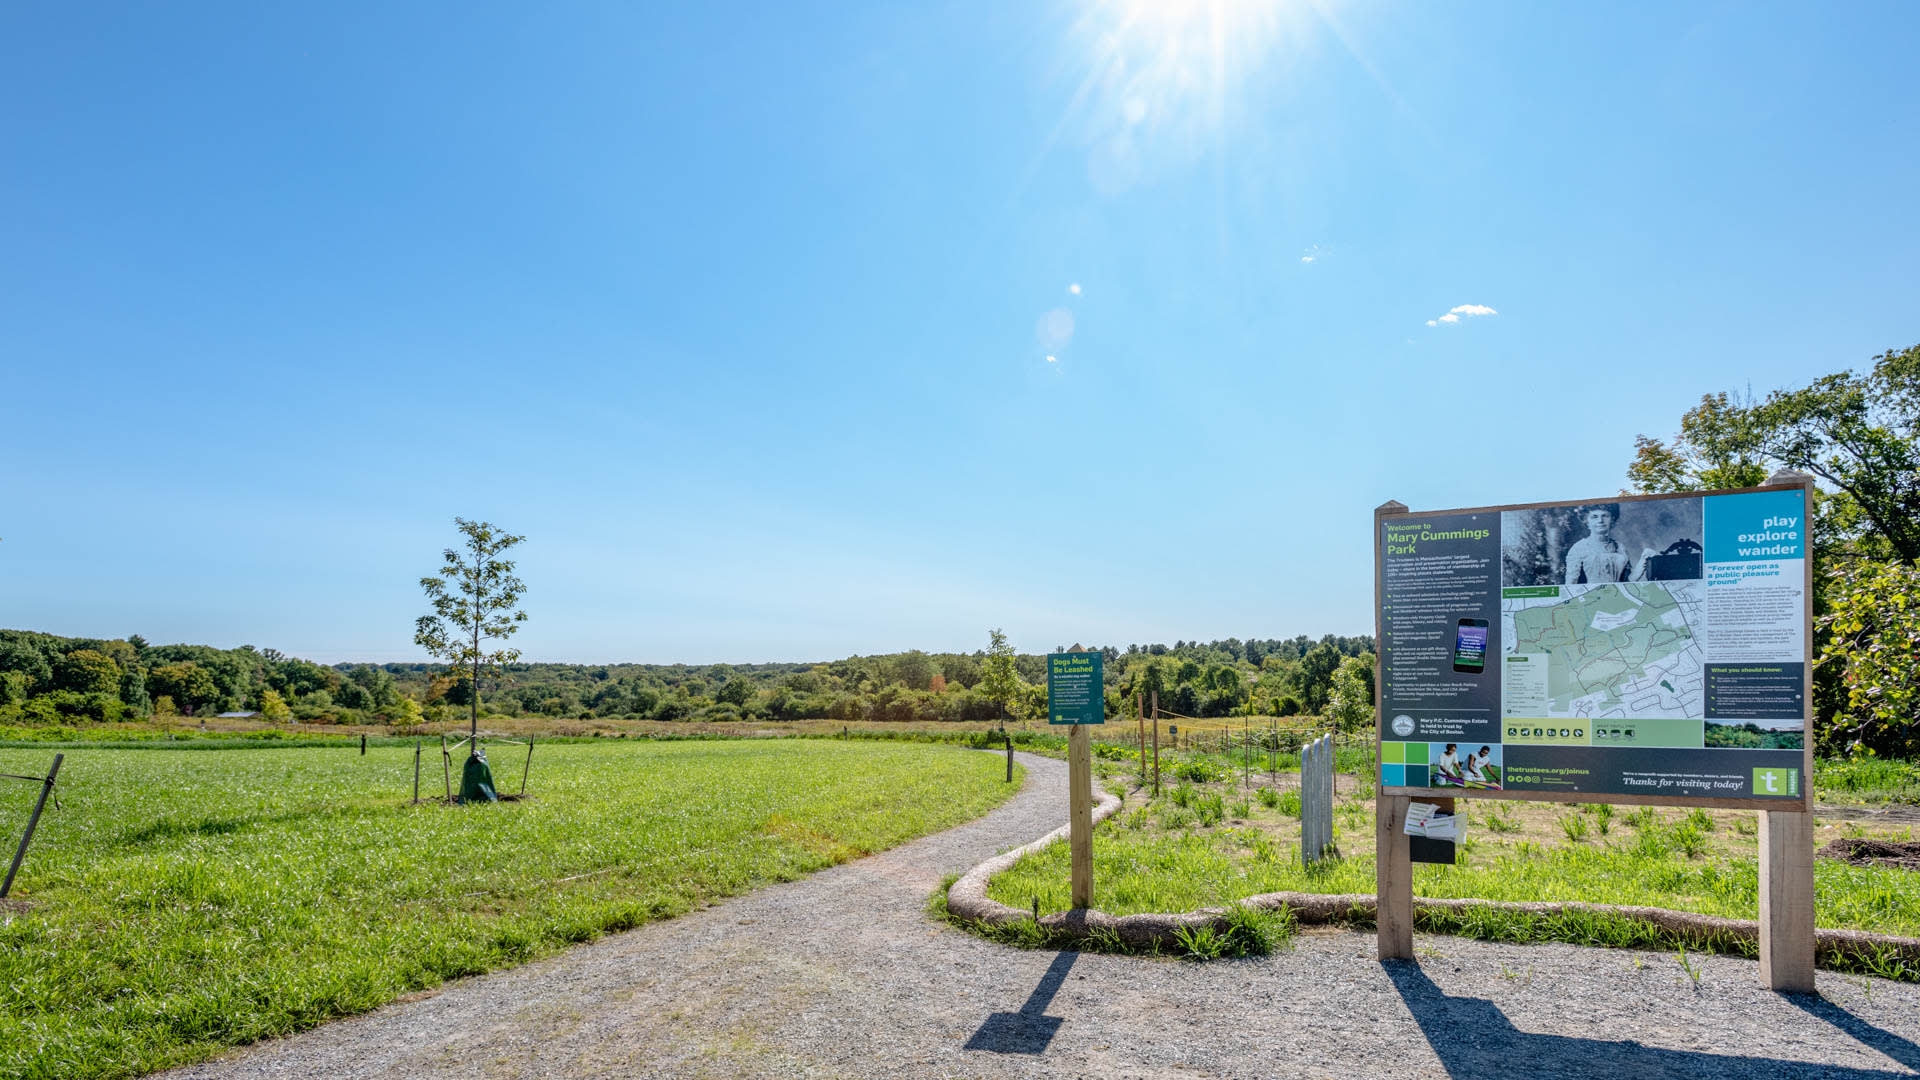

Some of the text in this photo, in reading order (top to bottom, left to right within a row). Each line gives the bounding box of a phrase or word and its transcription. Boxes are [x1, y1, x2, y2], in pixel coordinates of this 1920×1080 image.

[1764, 516, 1797, 529] play
[1388, 528, 1489, 544] Mary Cummings
[1738, 531, 1797, 543] explore
[1388, 544, 1416, 554] Park
[1738, 544, 1797, 556] wander
[1507, 766, 1590, 775] thetrustees.org/joinus
[1623, 777, 1744, 790] Thanks for visiting today!
[1760, 771, 1778, 792] t
